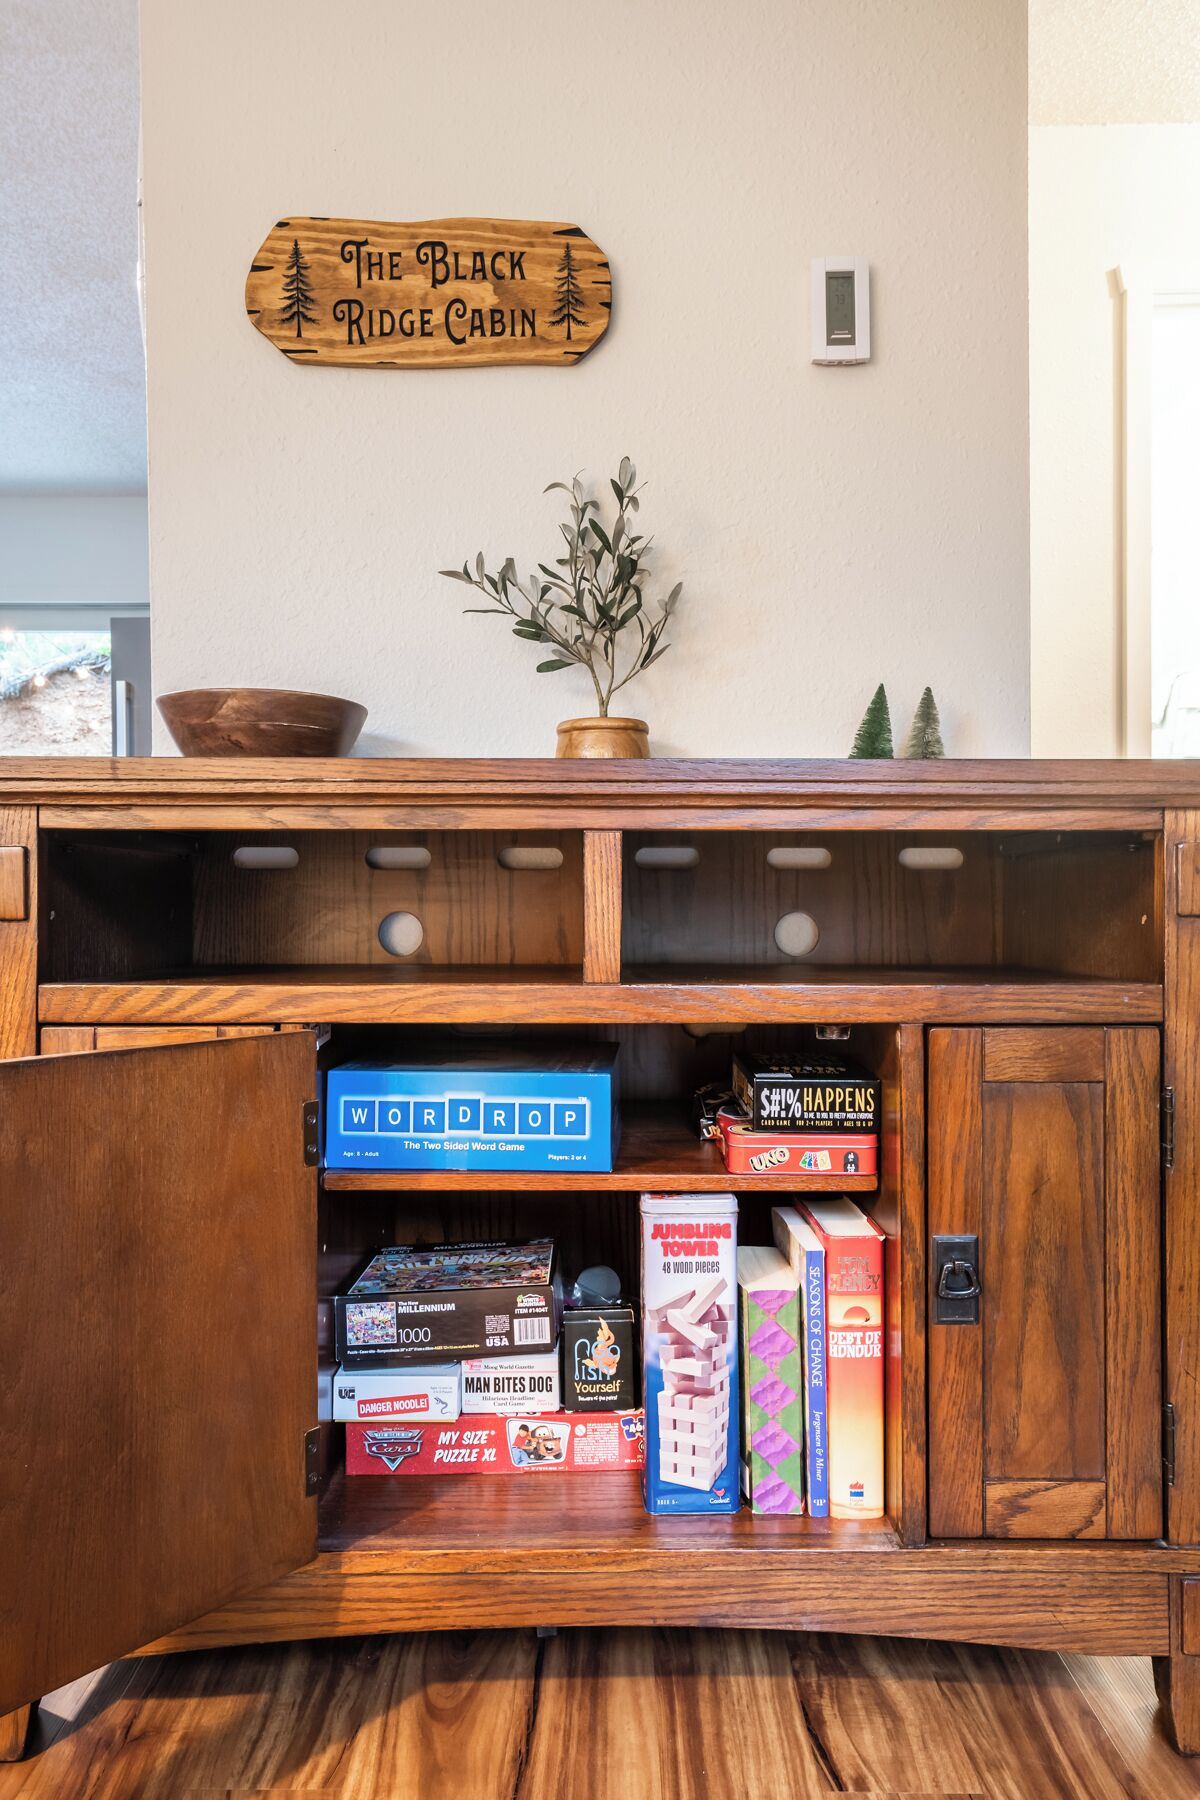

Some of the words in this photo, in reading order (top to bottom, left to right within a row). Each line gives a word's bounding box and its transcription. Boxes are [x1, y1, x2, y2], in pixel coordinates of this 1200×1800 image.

[341, 237, 403, 289] THE
[416, 240, 527, 290] BLACK
[333, 298, 435, 345] RIDGE
[444, 298, 537, 346] CABIN
[803, 1087, 875, 1112] HAPPENS
[351, 1106, 577, 1128] WORDROP
[404, 1141, 420, 1150] The
[423, 1141, 441, 1150] Two
[443, 1140, 470, 1150] Sided
[472, 1142, 496, 1151] Word
[498, 1142, 525, 1151] Game
[749, 1147, 790, 1172] UNO
[651, 1223, 732, 1240] JUMBLING
[661, 1240, 719, 1257] TOWER
[662, 1261, 671, 1274] 48
[673, 1261, 694, 1274] WOOD
[838, 1256, 870, 1274] TOM
[809, 1266, 821, 1316] SEASONS
[828, 1273, 881, 1292] CLANCY
[398, 1303, 456, 1314] MILLENNIUM
[398, 1327, 431, 1344] 1000
[810, 1320, 822, 1336] OF
[486, 1338, 510, 1347] USA
[828, 1330, 863, 1345] DEBT
[865, 1330, 882, 1345] OF
[828, 1344, 882, 1358] HONOUR
[810, 1339, 823, 1387] CHANGE
[465, 1377, 490, 1393] MAN
[493, 1377, 526, 1393] BITES
[529, 1376, 553, 1393] DOG
[574, 1380, 621, 1393] Yourself
[360, 1401, 392, 1414] DANGER
[437, 1431, 460, 1445] MY
[371, 1443, 413, 1453] Cars
[433, 1448, 479, 1463] PUZZLE
[481, 1447, 497, 1462] XL
[815, 1448, 824, 1457] &
[815, 1458, 825, 1482] Miner
